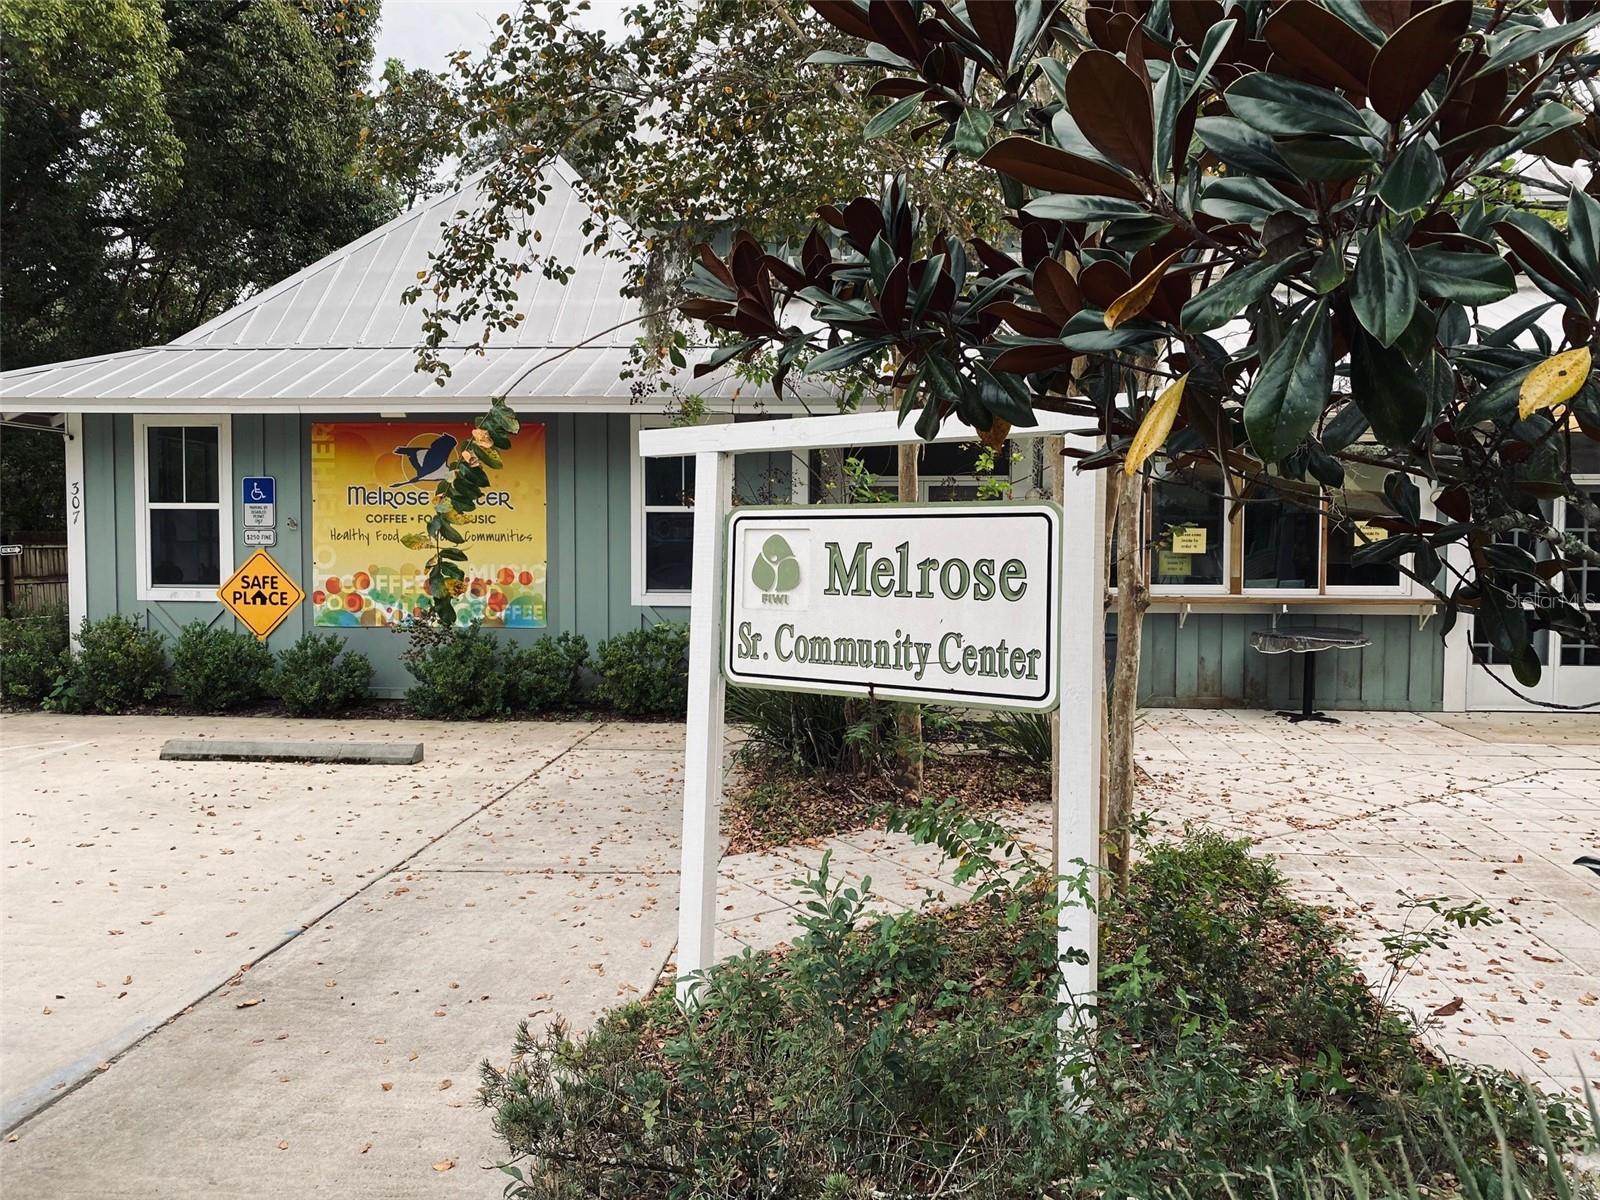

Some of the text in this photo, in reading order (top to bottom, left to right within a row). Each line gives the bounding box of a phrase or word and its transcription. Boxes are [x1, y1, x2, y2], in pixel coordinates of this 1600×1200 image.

[71, 481, 80, 525] 307
[366, 514, 407, 524] COFFEE
[330, 528, 370, 546] Healthy
[376, 528, 400, 543] Food
[464, 529, 533, 543] Communities
[241, 576, 278, 590] SAFE
[824, 541, 1028, 602] Melrose
[737, 621, 1041, 681] Sr. Community Center
